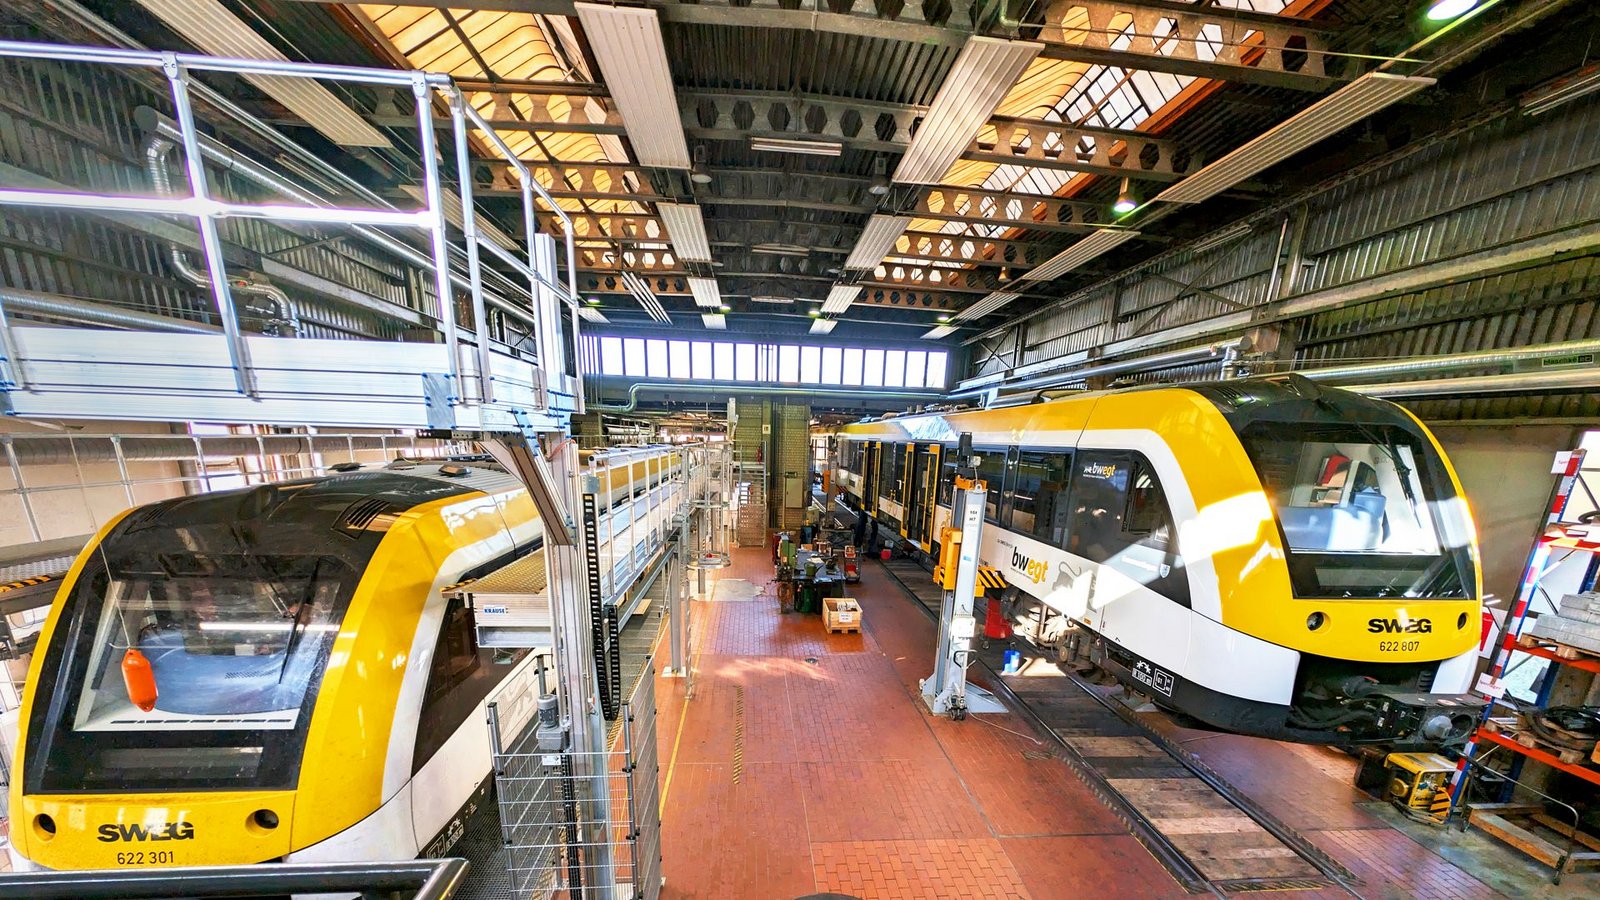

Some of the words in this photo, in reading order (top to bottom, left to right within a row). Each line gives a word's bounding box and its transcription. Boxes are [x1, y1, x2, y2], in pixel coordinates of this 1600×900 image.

[1092, 462, 1116, 479] bwegt
[1011, 546, 1049, 584] bwegt
[1367, 618, 1432, 633] SWEG
[1380, 641, 1399, 652] 622
[1401, 641, 1420, 652] 807
[97, 821, 194, 842] SWEG
[117, 852, 144, 865] 622
[149, 851, 174, 864] 301
